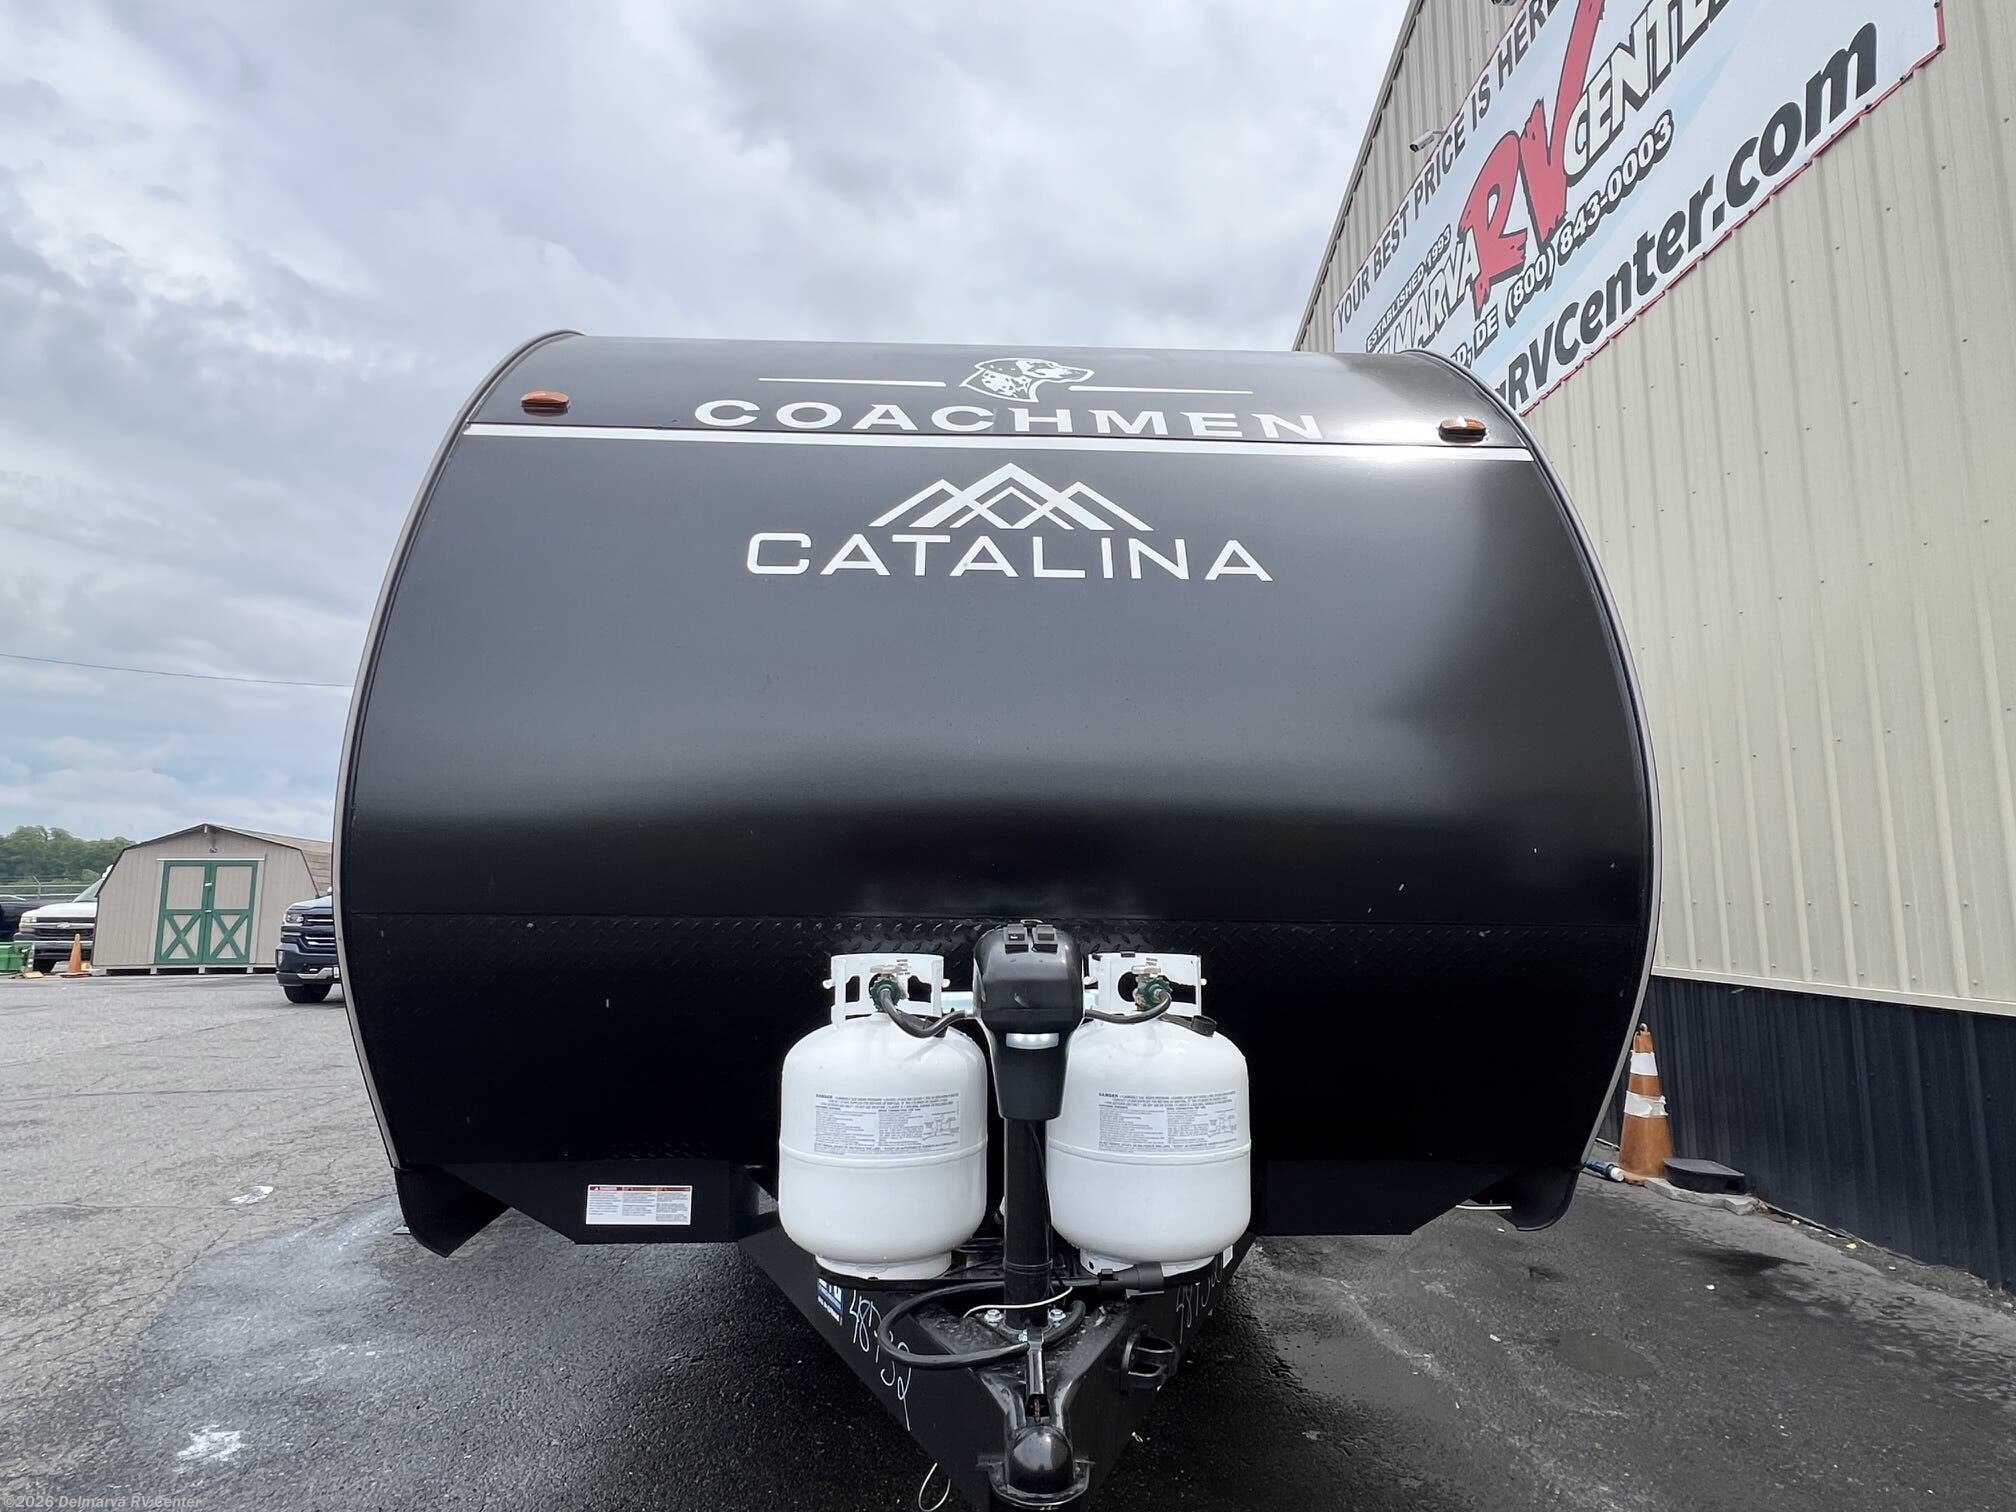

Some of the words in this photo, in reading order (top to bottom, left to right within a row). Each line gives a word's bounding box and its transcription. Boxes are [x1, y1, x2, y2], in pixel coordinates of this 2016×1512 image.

[1337, 265, 1370, 333] YOUR
[1374, 200, 1410, 282] BEST
[1413, 112, 1466, 220] PRICE
[1472, 74, 1491, 132] IS
[1473, 303, 1499, 359] DE
[1505, 240, 1555, 328] (800)
[1557, 109, 1674, 267] 843-0003
[1366, 262, 1425, 353] ESTABLISHED
[1425, 224, 1451, 275] 1993
[694, 399, 1323, 440] COACHMEN
[746, 531, 1273, 582] CATALINA
